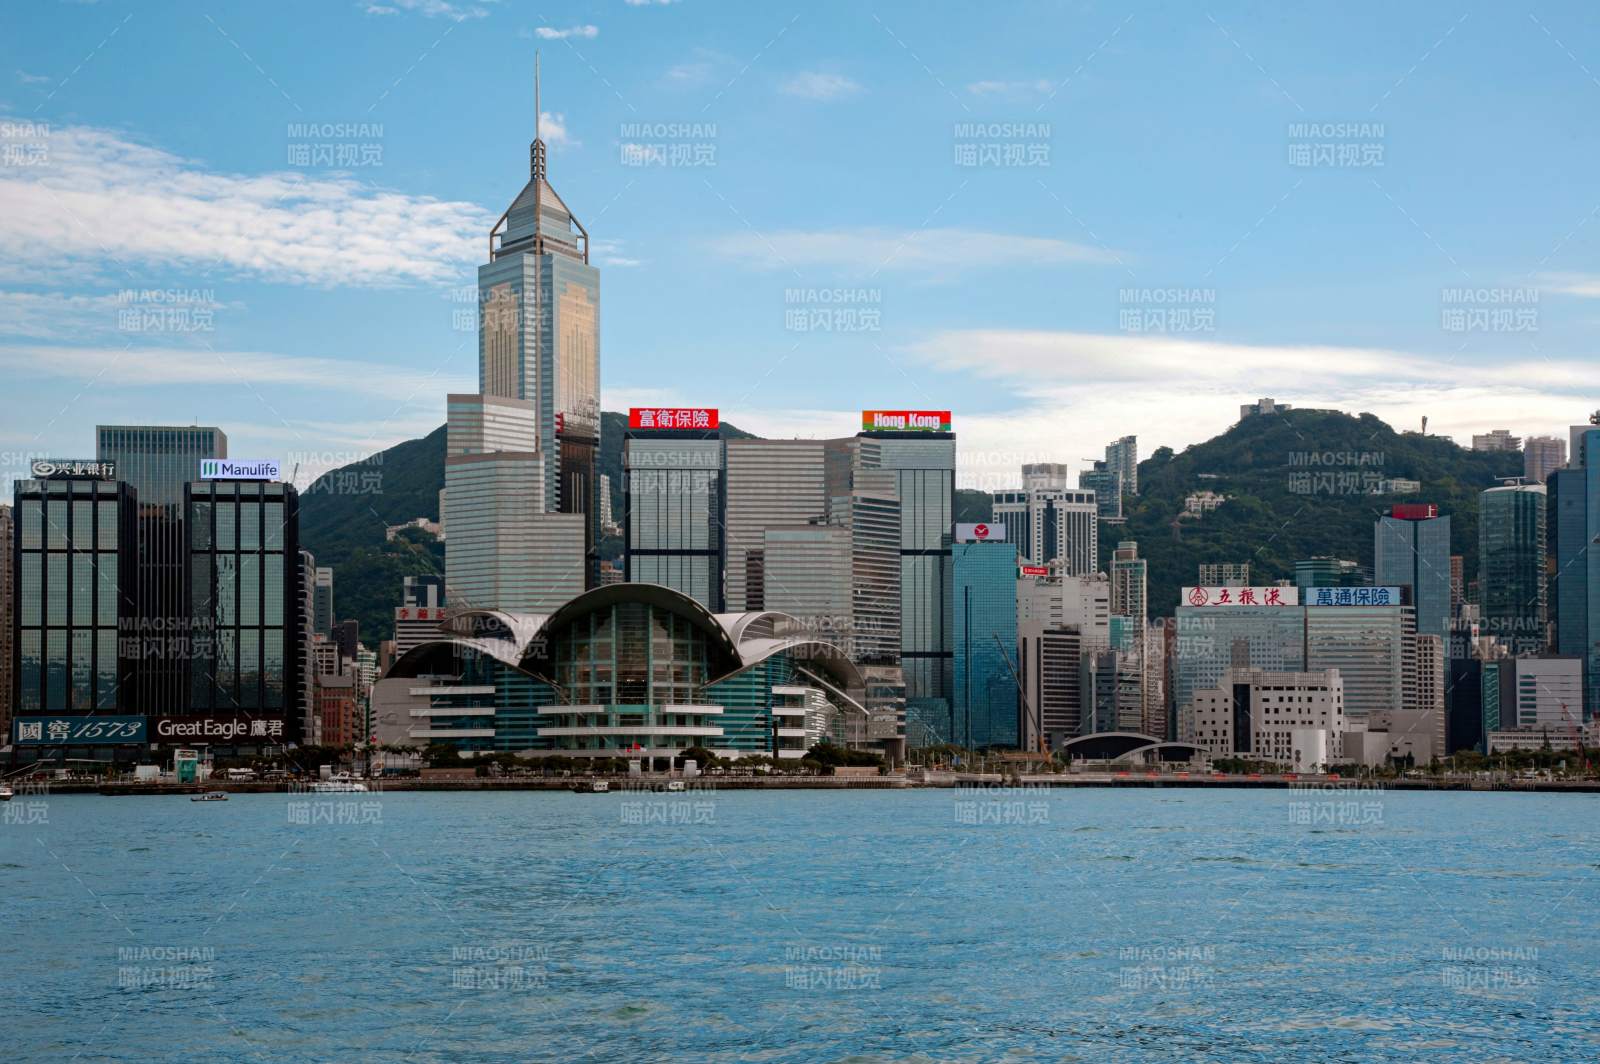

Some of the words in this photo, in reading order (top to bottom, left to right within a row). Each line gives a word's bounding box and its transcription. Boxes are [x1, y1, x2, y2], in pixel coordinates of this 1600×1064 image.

[639, 409, 709, 428] 富衛保險
[873, 413, 906, 429] Hong
[908, 413, 940, 429] Kong
[56, 462, 115, 476] 兴业银行
[222, 463, 277, 476] Manulife
[1316, 588, 1391, 606] 萬通保險
[157, 719, 202, 736] Great
[204, 718, 248, 739] Eagle
[250, 720, 284, 737] 鷹君
